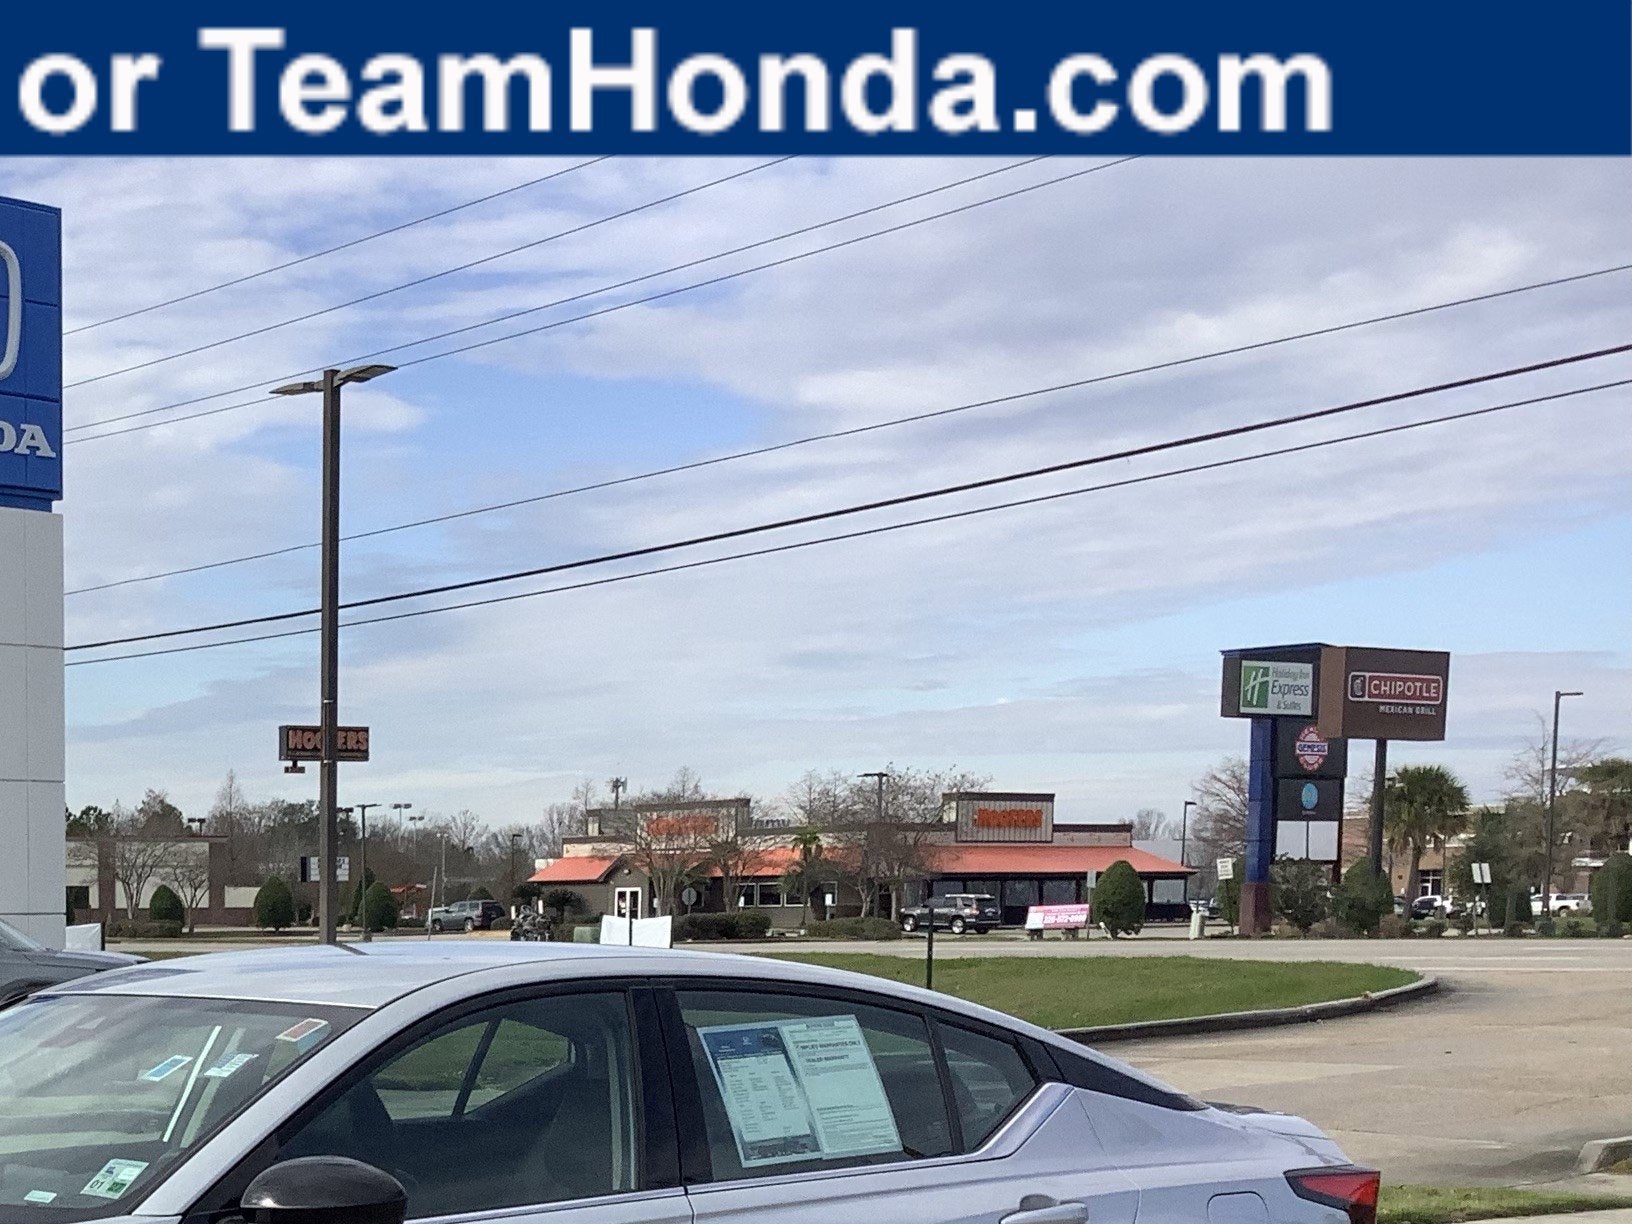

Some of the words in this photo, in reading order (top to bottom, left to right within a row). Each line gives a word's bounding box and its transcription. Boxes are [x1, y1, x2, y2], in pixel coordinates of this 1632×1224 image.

[1271, 680, 1309, 698] Express
[1370, 680, 1438, 697] CHIPOTLE
[1378, 705, 1414, 714] MEXICAN
[1415, 706, 1436, 715] GRILL
[289, 730, 368, 750] HOERS
